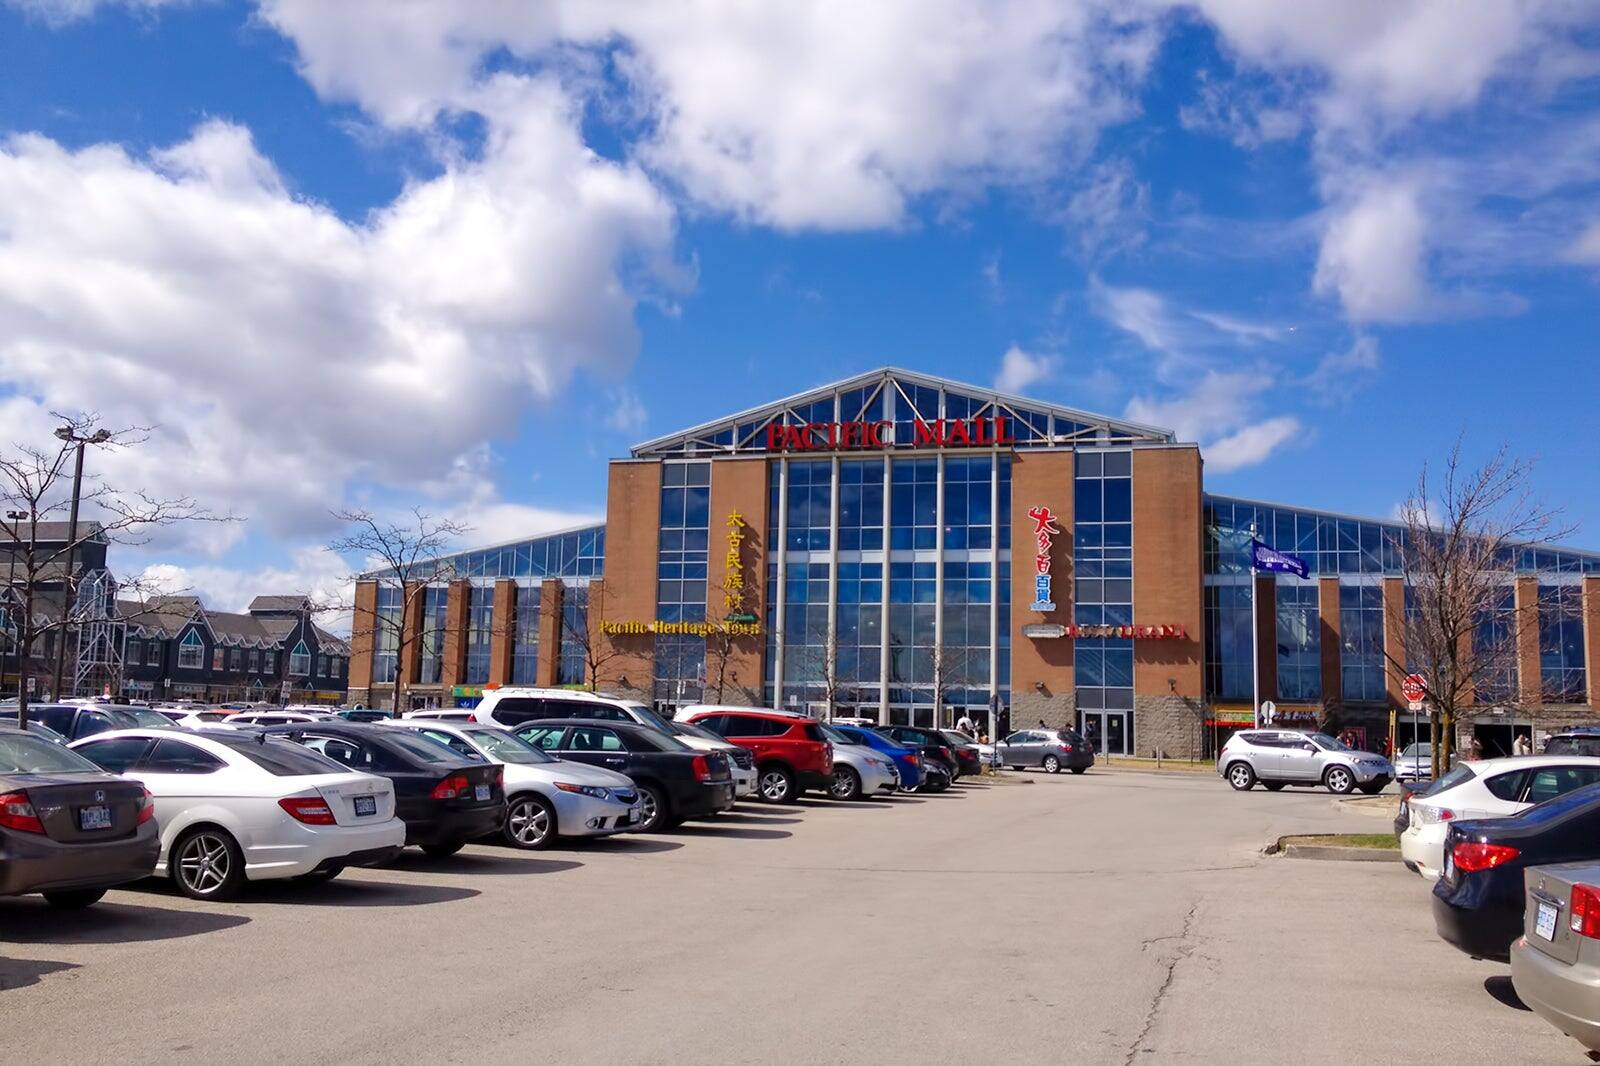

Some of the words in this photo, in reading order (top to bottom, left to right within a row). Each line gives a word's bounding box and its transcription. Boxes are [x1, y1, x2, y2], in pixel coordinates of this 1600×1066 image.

[766, 420, 893, 449] PACIFIC
[912, 415, 1014, 446] MALL
[599, 620, 648, 635] Pacific
[653, 619, 716, 637] Heritage
[723, 620, 761, 635] Town
